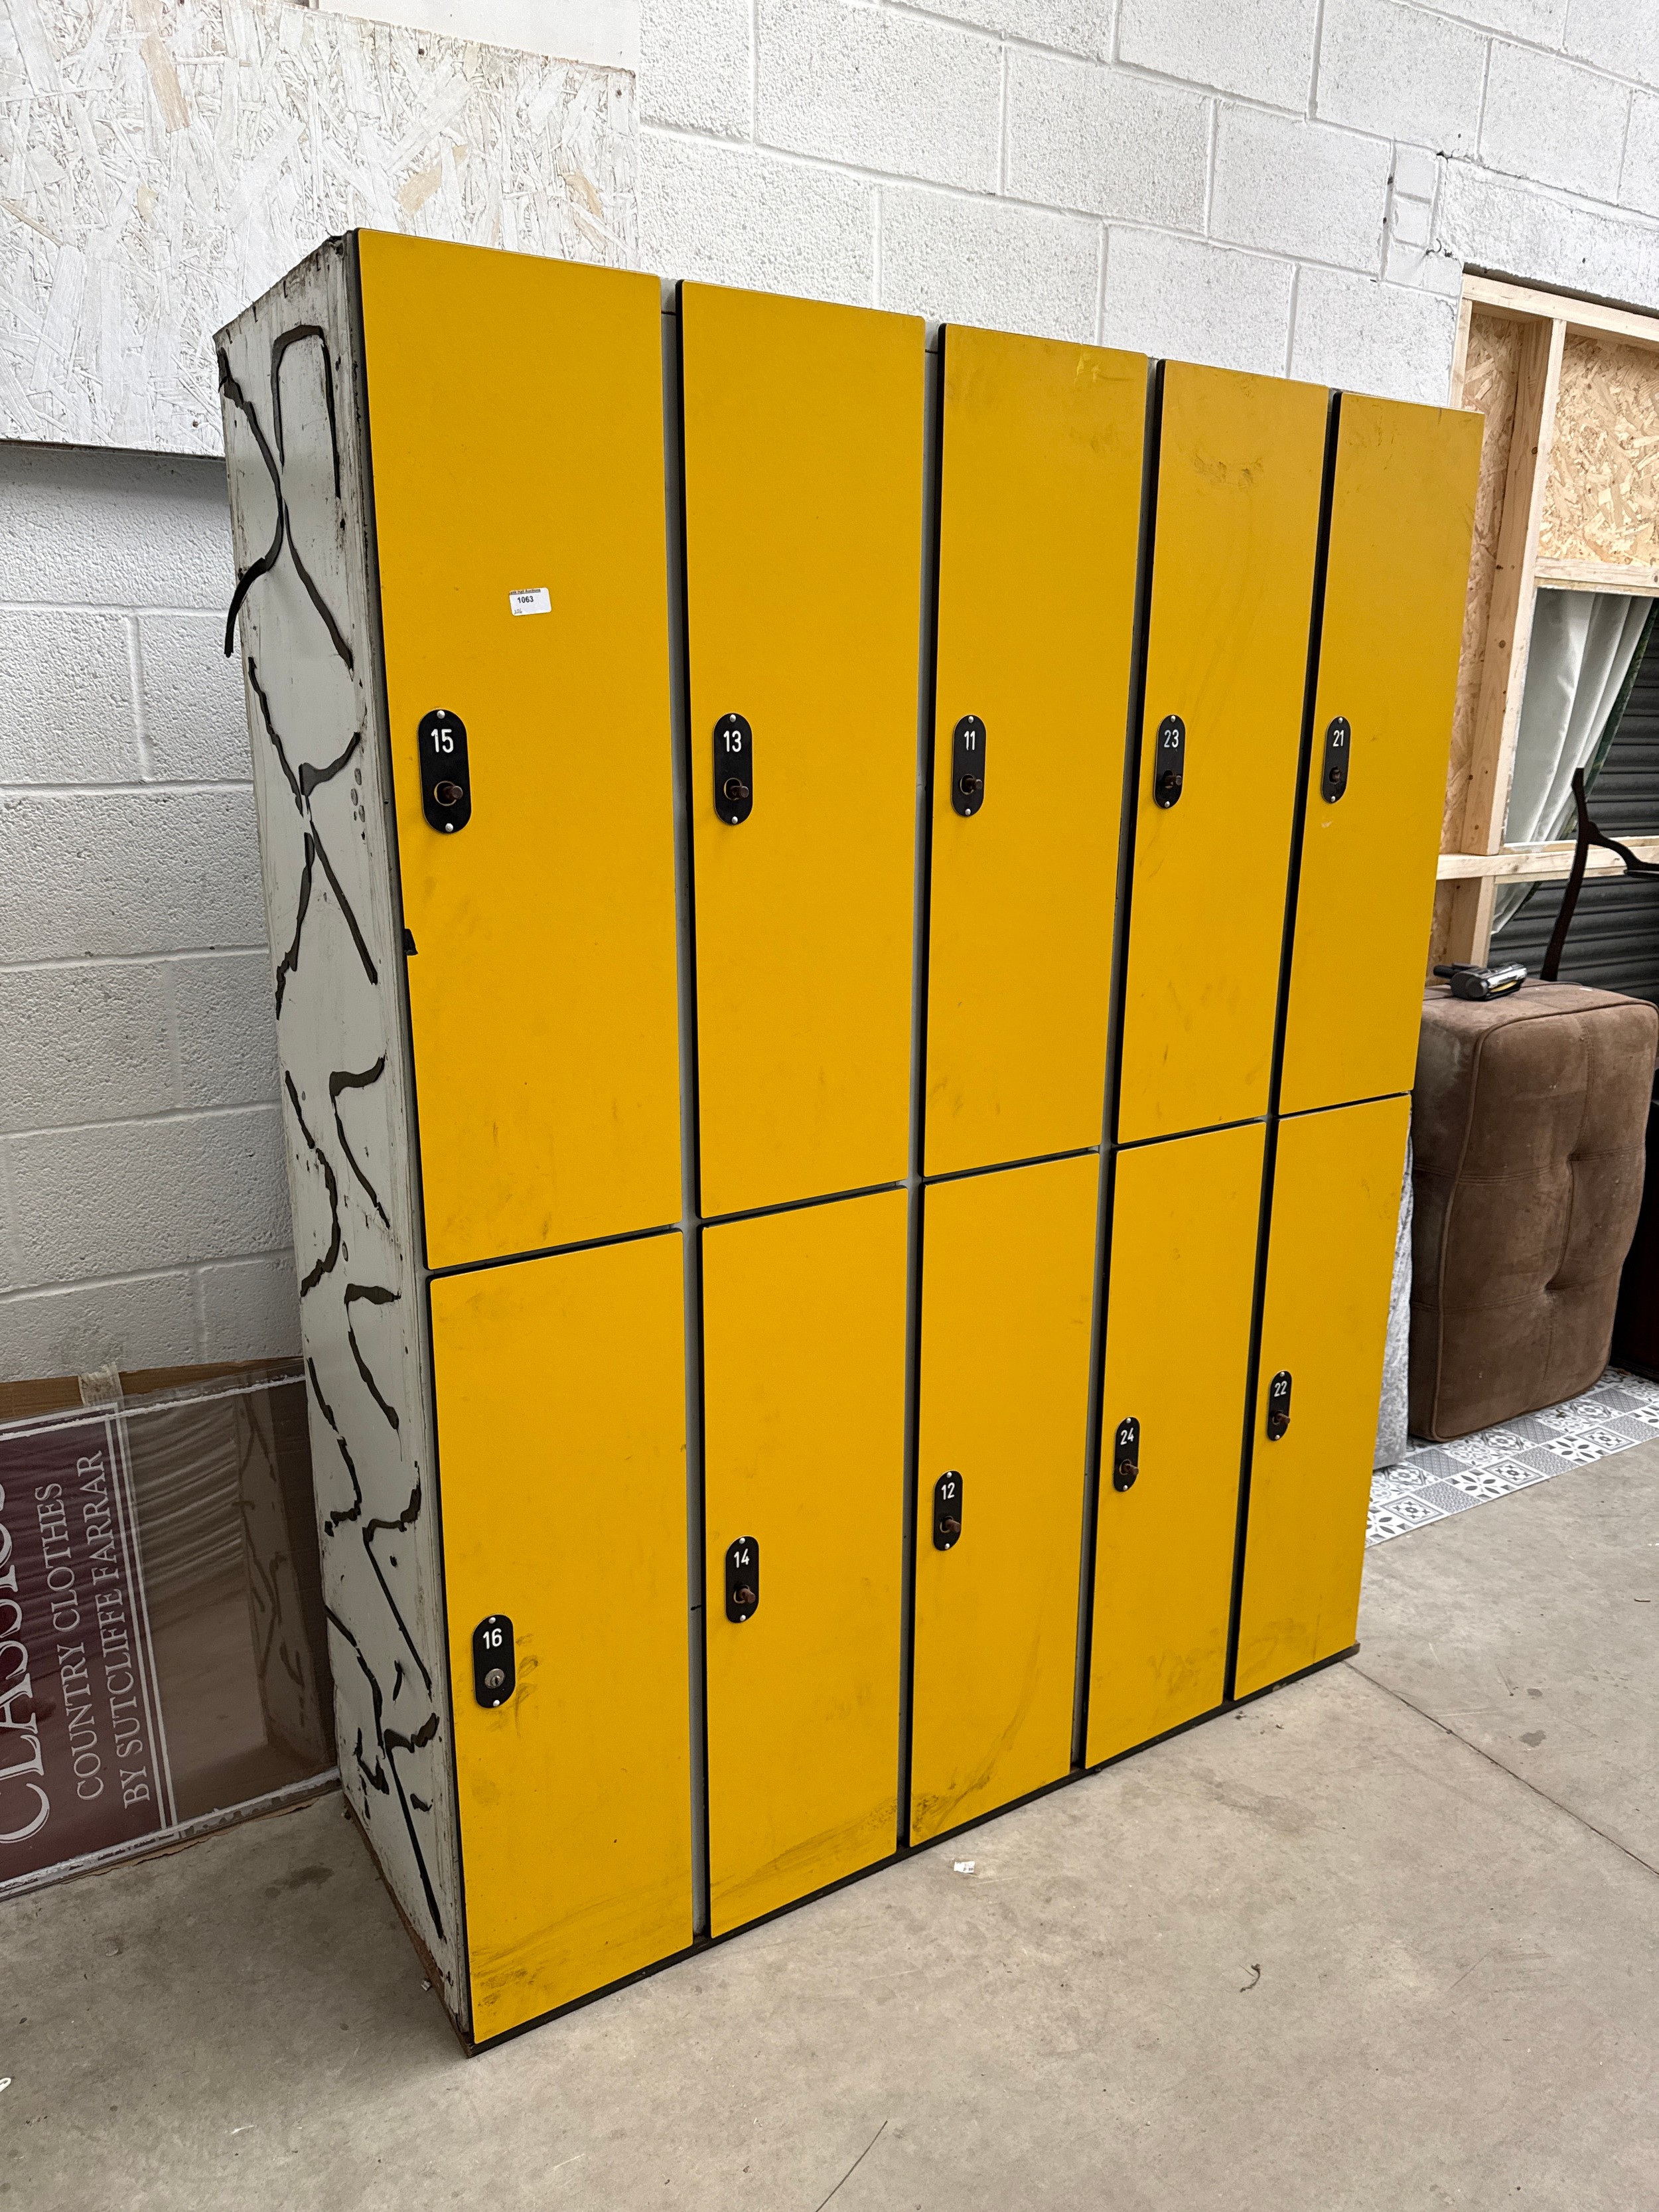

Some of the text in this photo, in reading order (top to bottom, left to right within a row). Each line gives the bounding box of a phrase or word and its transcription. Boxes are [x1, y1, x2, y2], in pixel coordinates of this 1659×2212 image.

[431, 728, 454, 753] 15
[723, 730, 742, 753] 13
[964, 730, 975, 751] 11
[1163, 729, 1179, 748] 23
[1333, 729, 1344, 747] 21
[1273, 1380, 1287, 1397] 22
[1120, 1427, 1134, 1445] 24
[941, 1482, 956, 1501] 12
[733, 1548, 750, 1568] 14
[76, 1449, 151, 1809] BY SUTCLIFFE FARRAR
[482, 1628, 502, 1650] 16
[35, 1483, 104, 1801] COUNTRY CLOTHES
